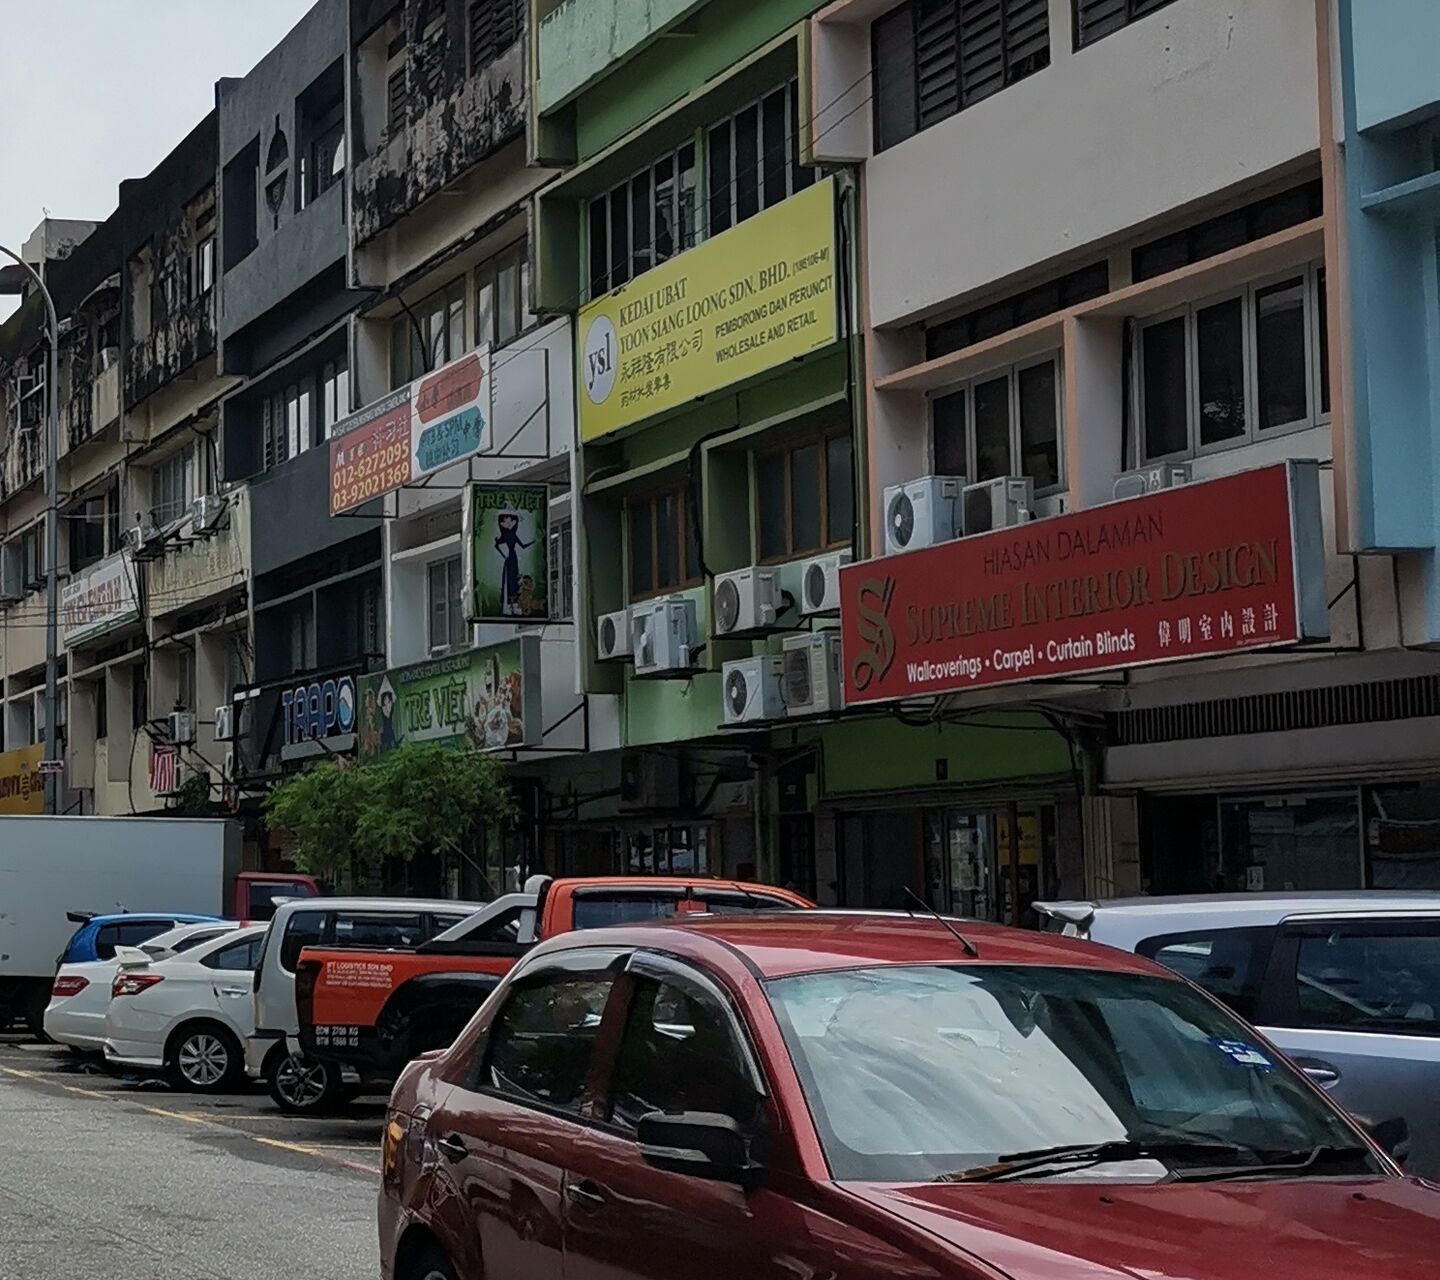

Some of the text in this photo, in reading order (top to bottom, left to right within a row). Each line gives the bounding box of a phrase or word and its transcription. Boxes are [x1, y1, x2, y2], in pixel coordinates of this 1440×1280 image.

[619, 277, 689, 328] KEDAI UBAT
[619, 326, 650, 355] YOON
[651, 313, 685, 344] SIANG
[686, 292, 728, 326] LOONG
[728, 275, 757, 305] SDN.
[759, 261, 791, 290] BHD.
[715, 275, 833, 338] PEMBORONG DAN PERUNCIT
[588, 331, 612, 390] ysl
[715, 331, 766, 363] WHOLESALE
[767, 322, 786, 342] AND
[786, 310, 817, 333] RETAIL
[333, 438, 410, 489] 012-6272095
[333, 462, 410, 511] 03-92021369
[983, 513, 1165, 577] HIASAN DALAMAN
[905, 537, 1280, 647] SUPREME INTERIOR DESIGN
[906, 628, 1136, 684] Wallcoverings Carpet Curtain Blinds
[282, 675, 356, 745] TRAPO
[405, 690, 432, 732] TRE
[349, 1027, 358, 1035] KG
[349, 1037, 358, 1046] KG
